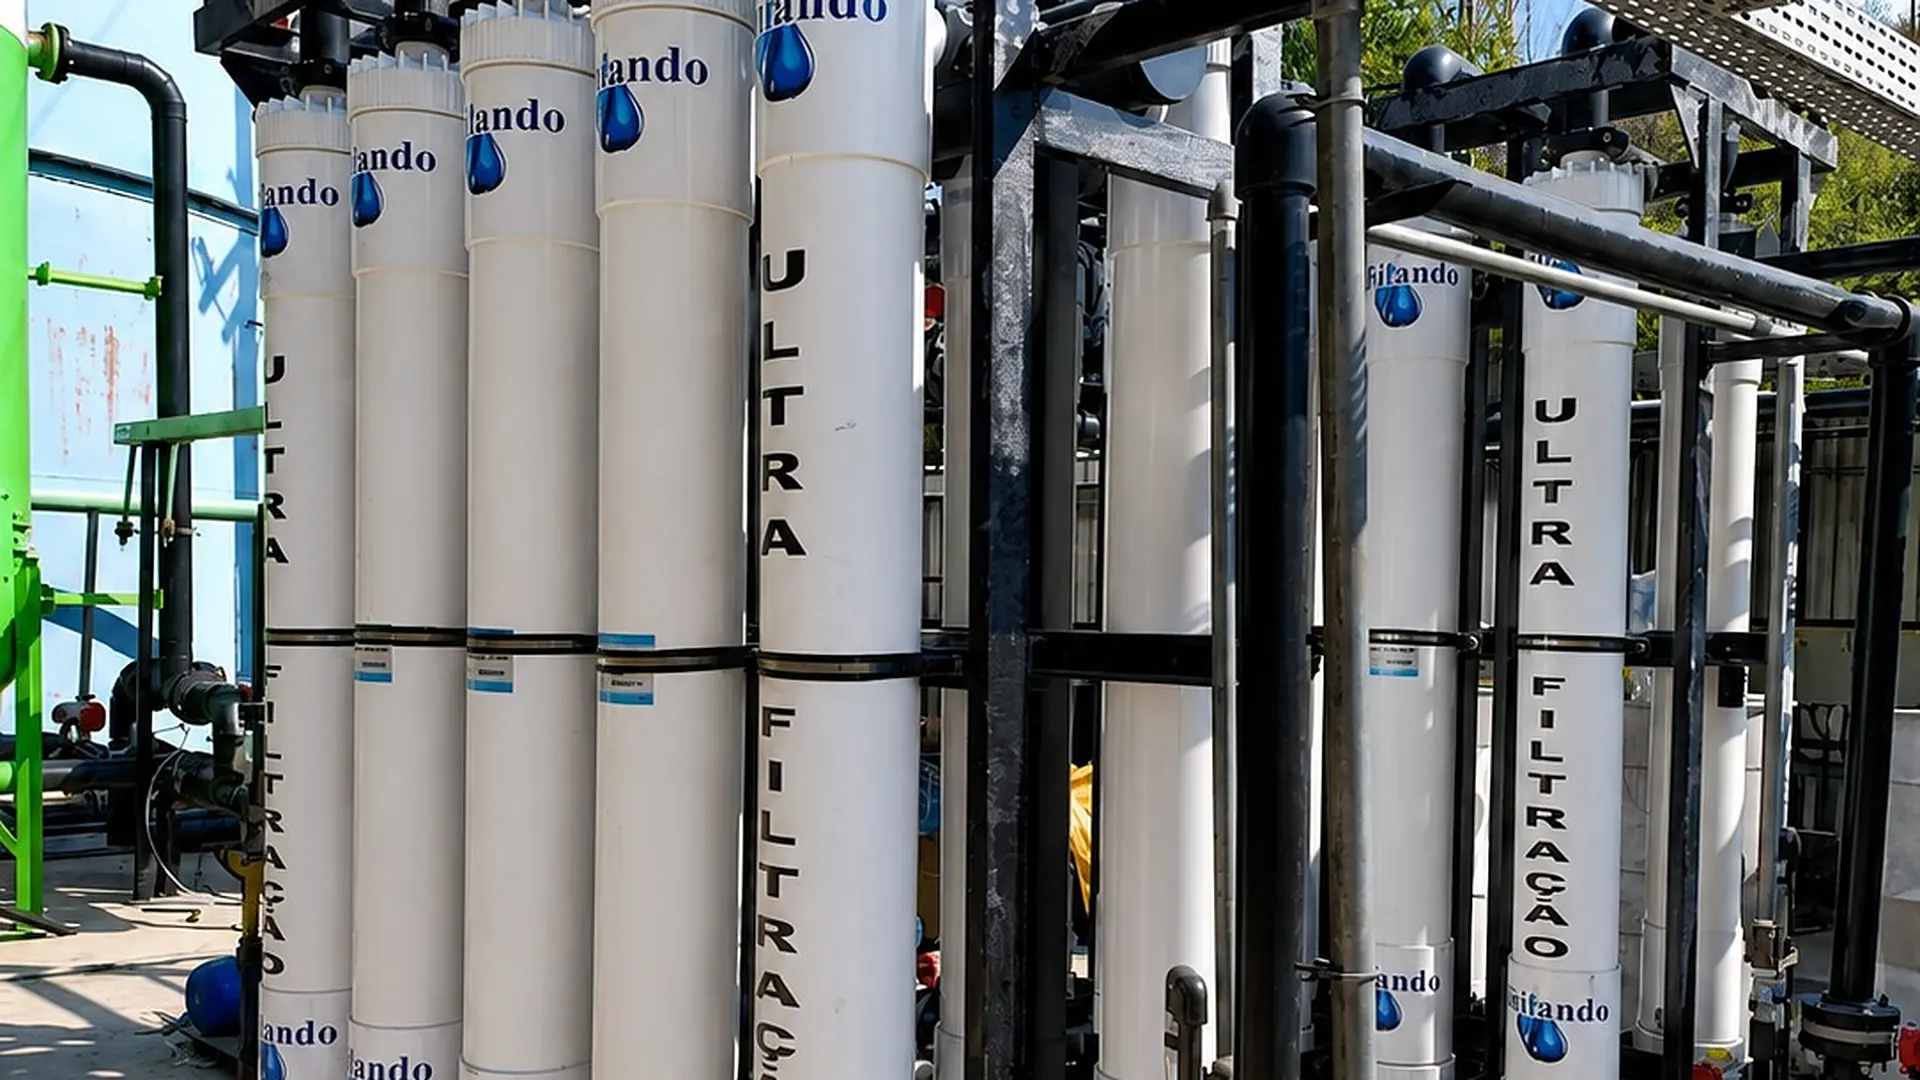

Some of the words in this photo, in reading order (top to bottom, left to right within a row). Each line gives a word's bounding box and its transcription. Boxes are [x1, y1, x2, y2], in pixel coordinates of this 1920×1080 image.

[762, 249, 806, 556] ULTRA
[1530, 398, 1577, 586] ULTRA
[756, 706, 800, 1080] FILTRAÇ
[1524, 677, 1569, 958] FILTRAÇÃO
